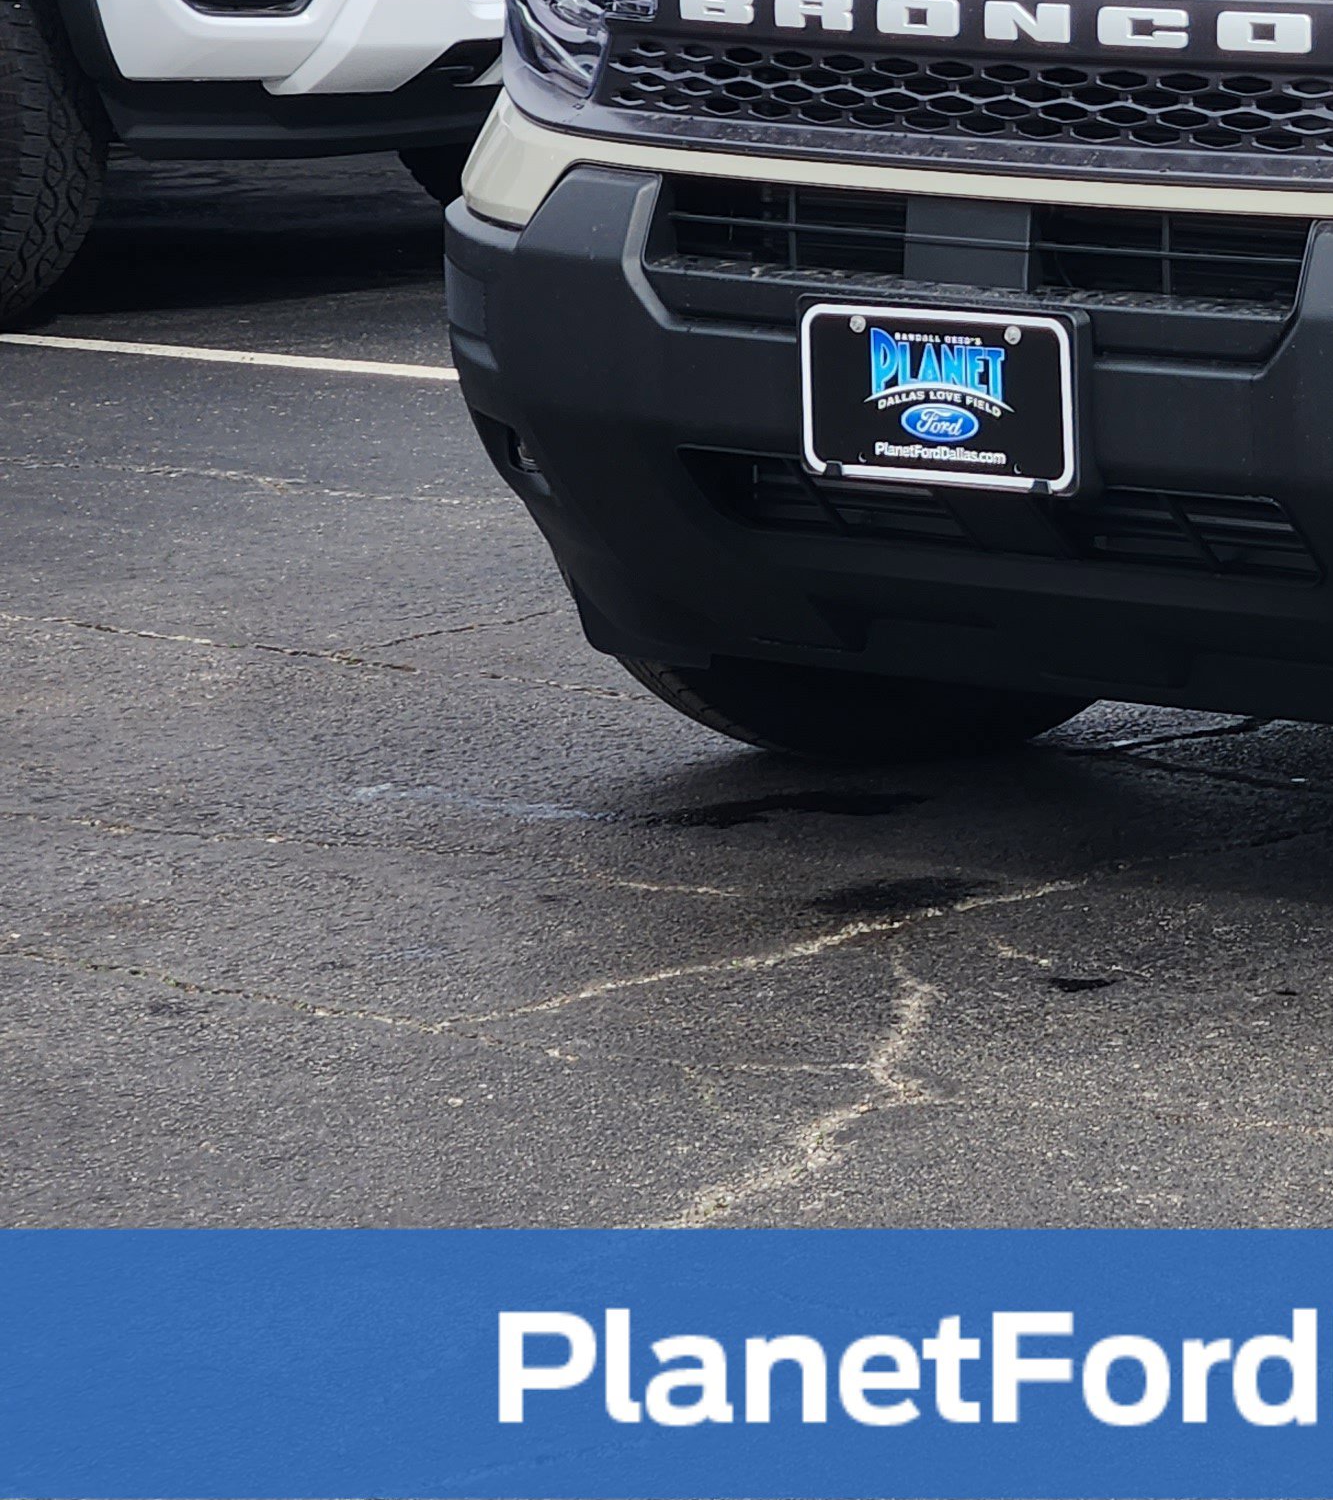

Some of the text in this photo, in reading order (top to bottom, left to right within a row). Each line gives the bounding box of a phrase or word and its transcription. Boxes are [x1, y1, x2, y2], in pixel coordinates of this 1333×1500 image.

[870, 327, 1006, 402] PLANET
[877, 390, 1002, 418] DALLAS LOVE FIELD
[915, 408, 964, 436] Ford
[874, 441, 1007, 465] PlanetFordDallas.com
